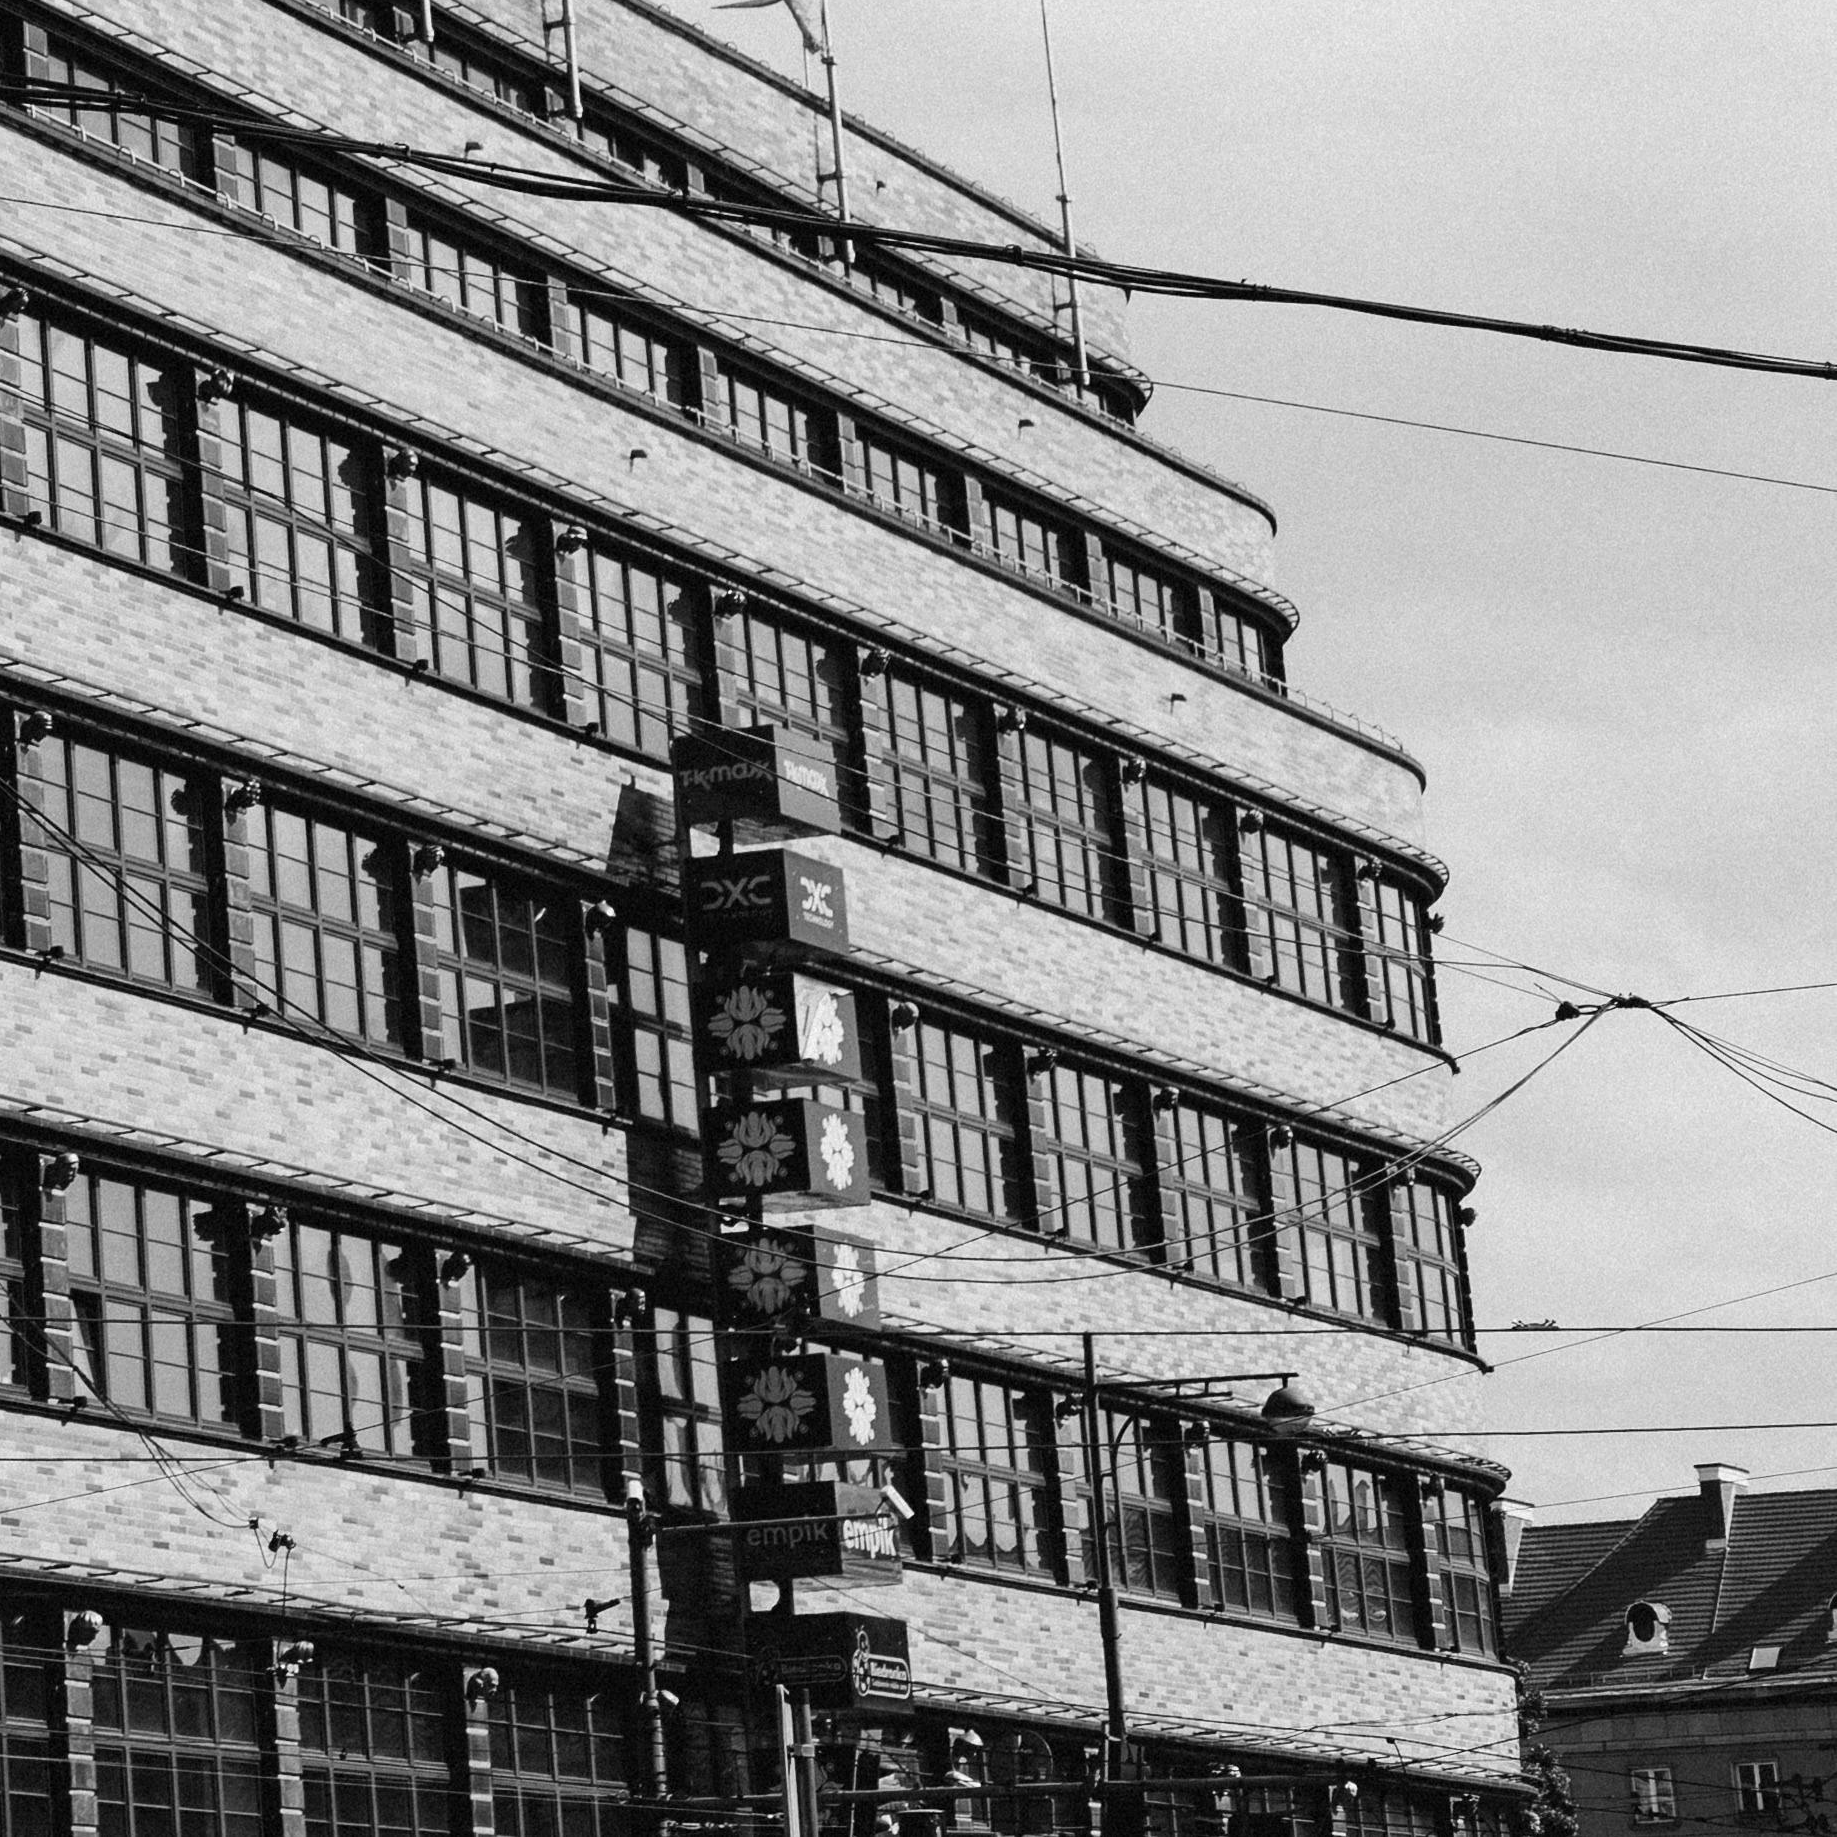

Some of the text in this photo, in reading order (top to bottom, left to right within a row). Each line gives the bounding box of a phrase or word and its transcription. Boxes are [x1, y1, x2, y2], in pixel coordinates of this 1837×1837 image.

[700, 875, 772, 910] DXC
[800, 876, 834, 918] DXC
[746, 1522, 828, 1548] empik
[843, 1511, 897, 1560] empik
